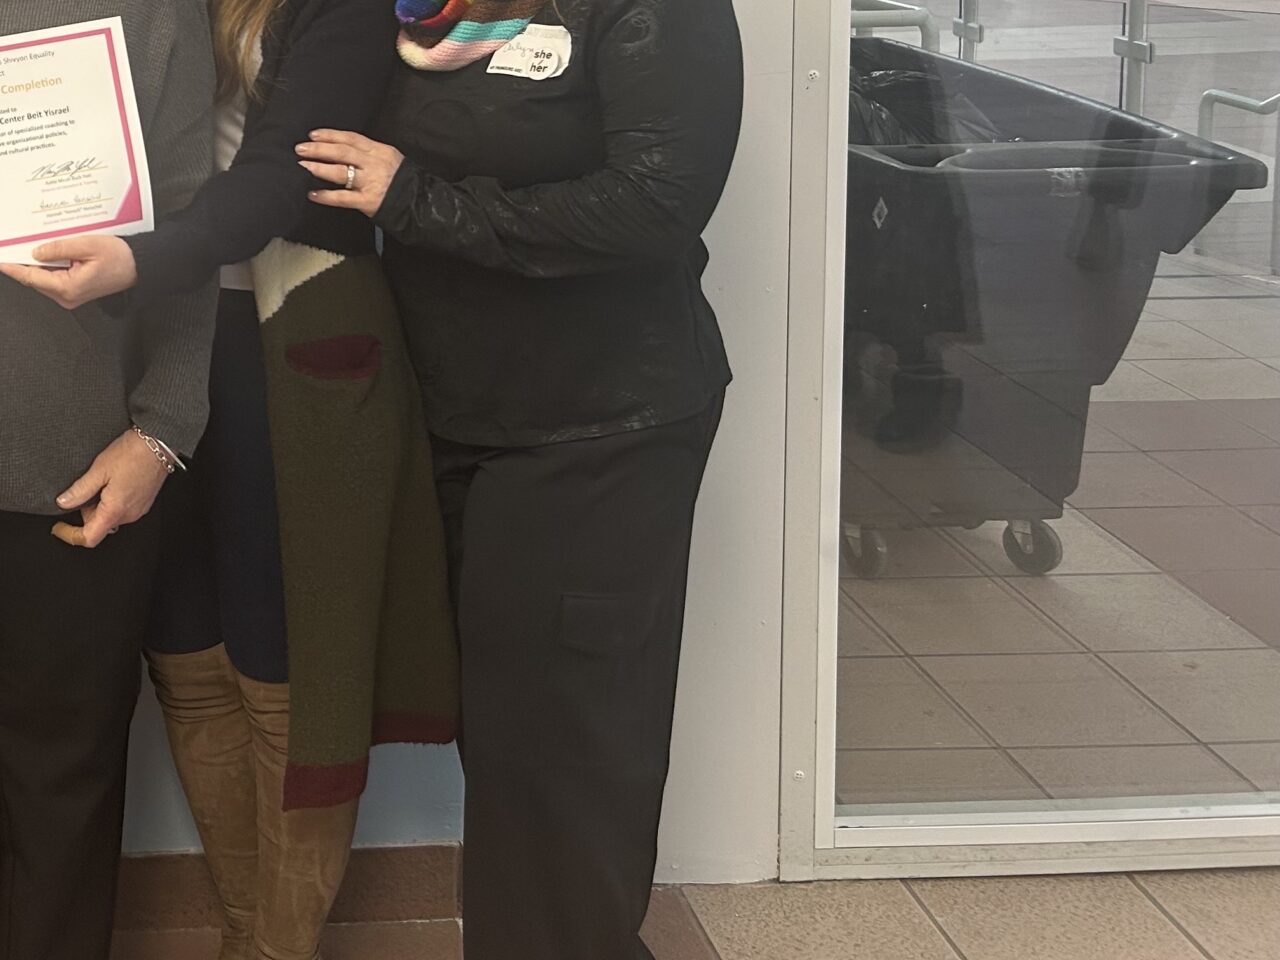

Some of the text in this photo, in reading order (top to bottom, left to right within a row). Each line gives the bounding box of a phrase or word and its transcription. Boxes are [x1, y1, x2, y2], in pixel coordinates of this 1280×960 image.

[3, 54, 29, 66] Shivyon
[29, 50, 55, 62] Equality
[533, 49, 552, 59] she
[529, 61, 548, 73] her
[0, 76, 63, 94] Completion
[0, 115, 25, 127] Center
[26, 111, 42, 120] Beit
[43, 106, 70, 117] Yisrael
[14, 124, 44, 136] specialized
[44, 120, 69, 131] coaching
[6, 133, 45, 147] organizational
[8, 145, 30, 155] cultural
